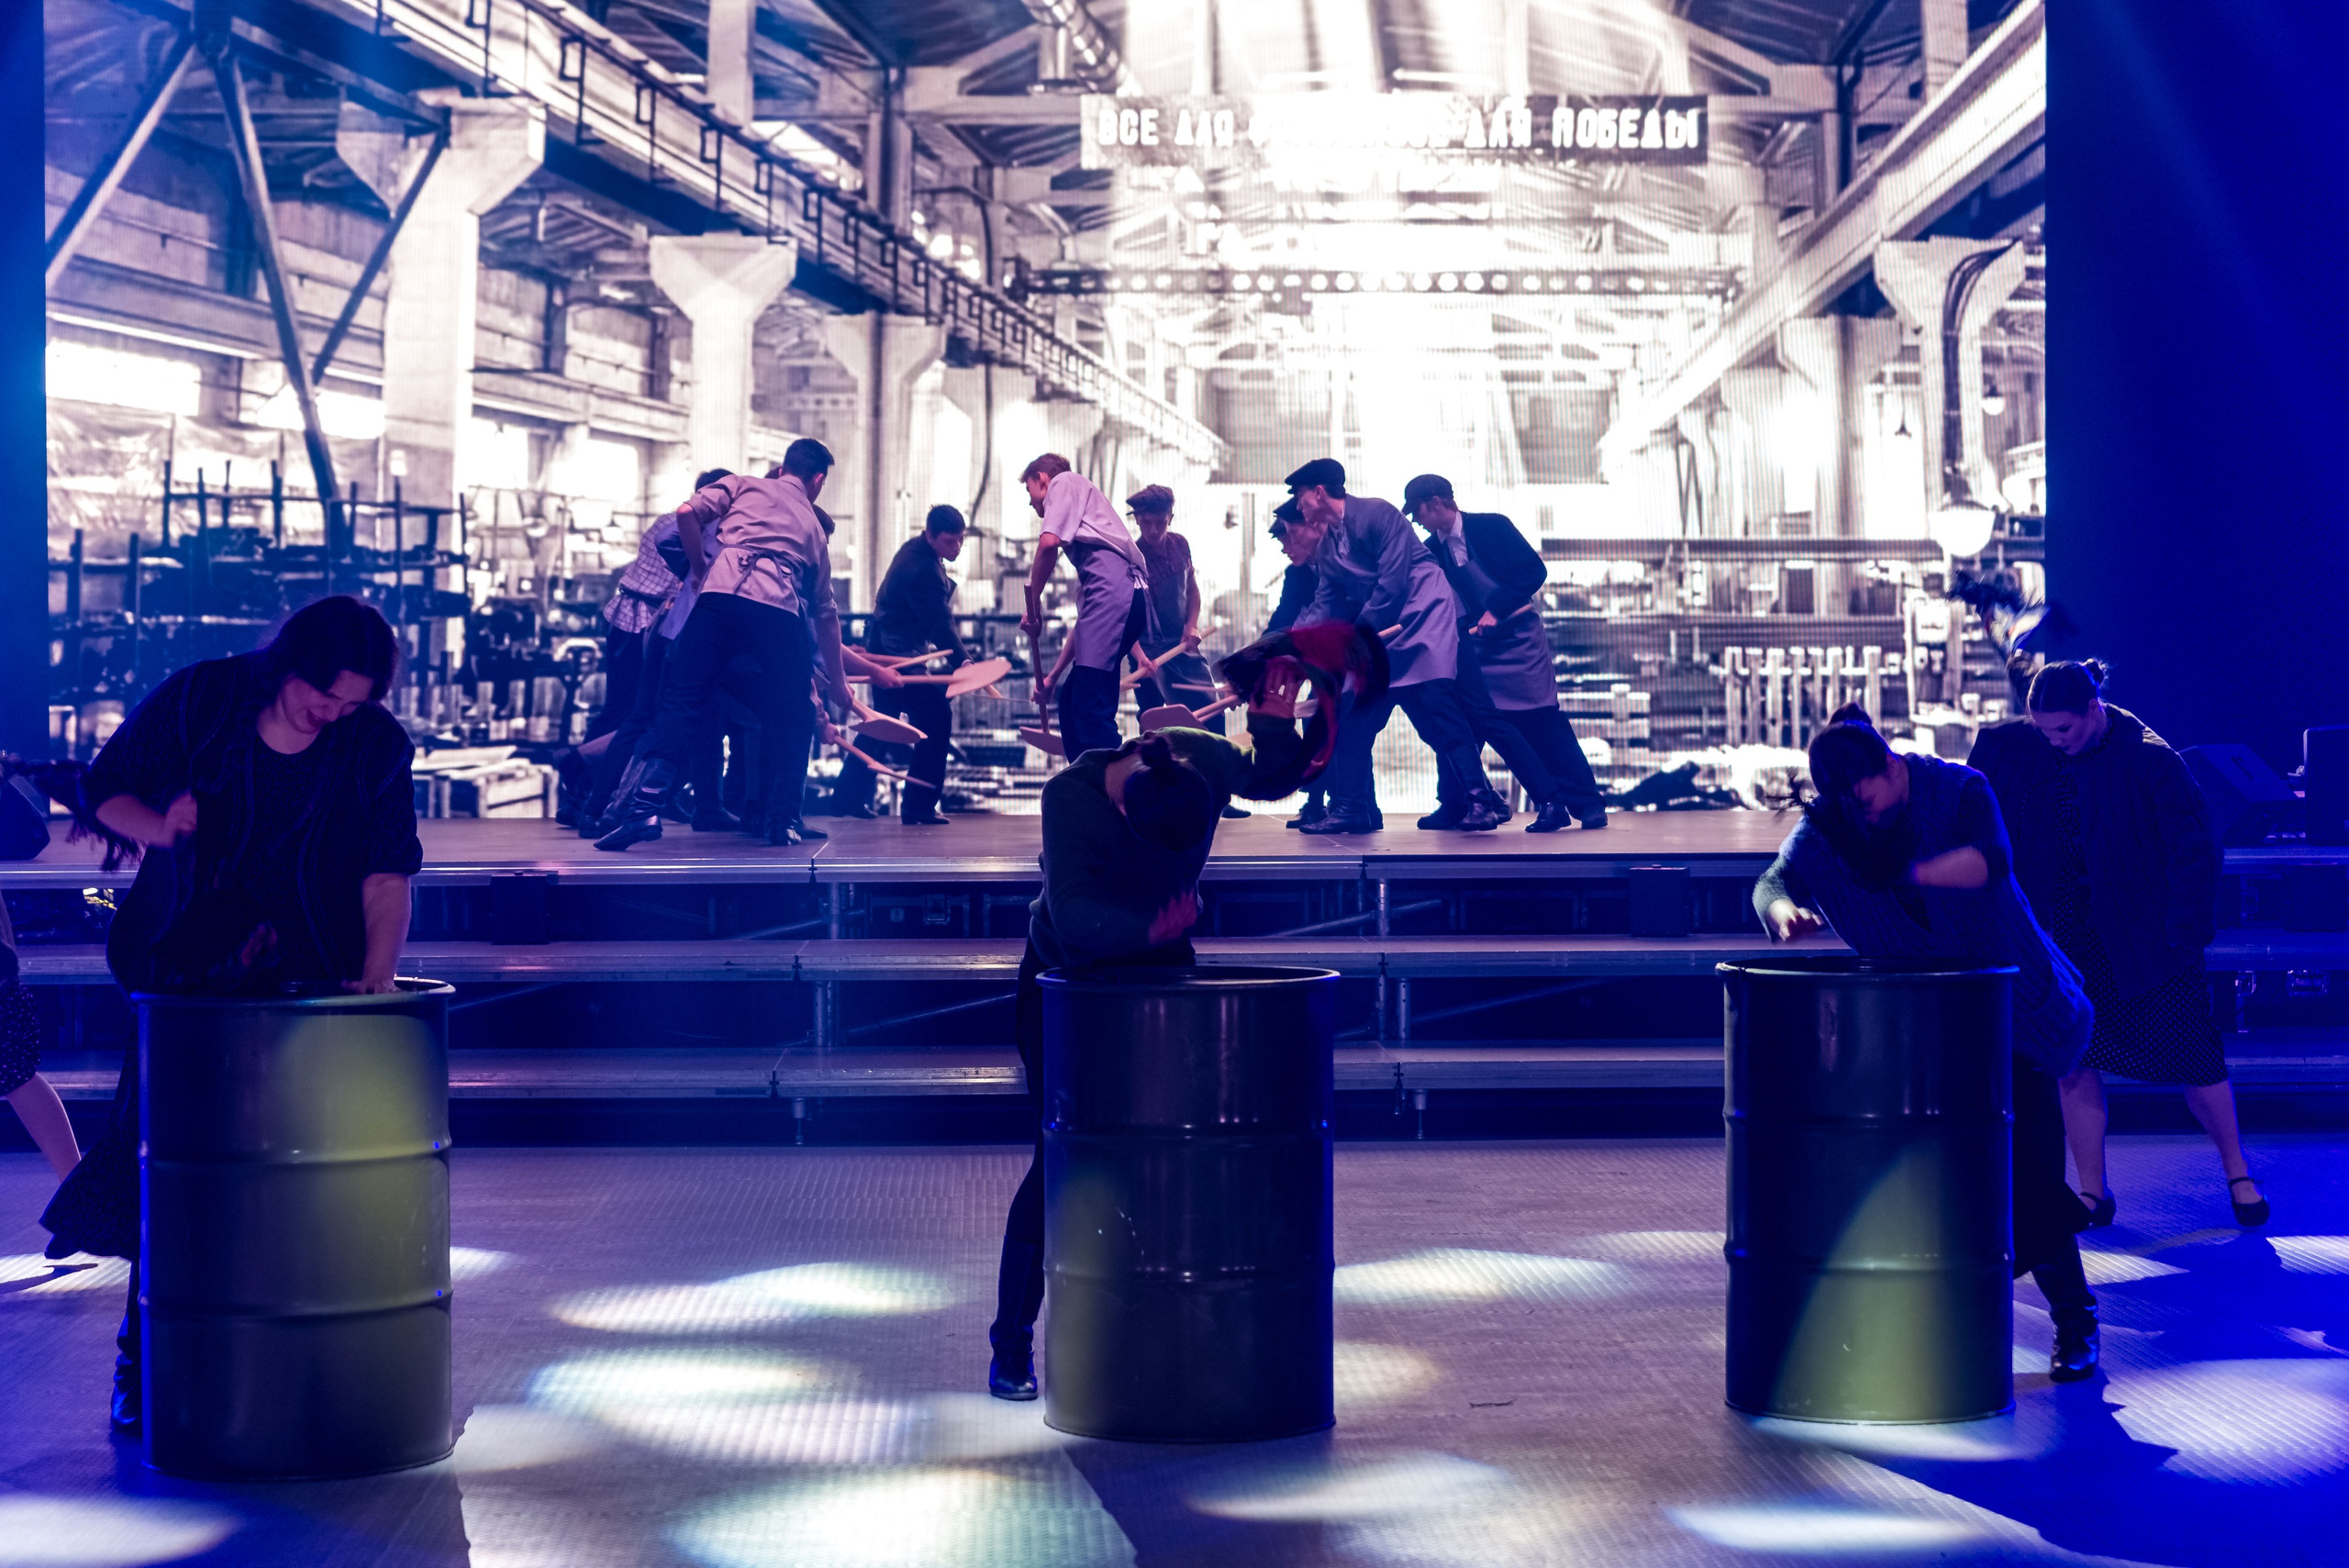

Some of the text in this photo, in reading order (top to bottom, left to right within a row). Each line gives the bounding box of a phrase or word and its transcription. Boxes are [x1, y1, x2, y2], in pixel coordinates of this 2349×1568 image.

[1098, 108, 1159, 146] ВСЕ
[1174, 108, 1234, 147] ДЛЯ
[1464, 107, 1531, 148] ДЛЯ
[1552, 106, 1698, 149] ПОБЕДЫ
